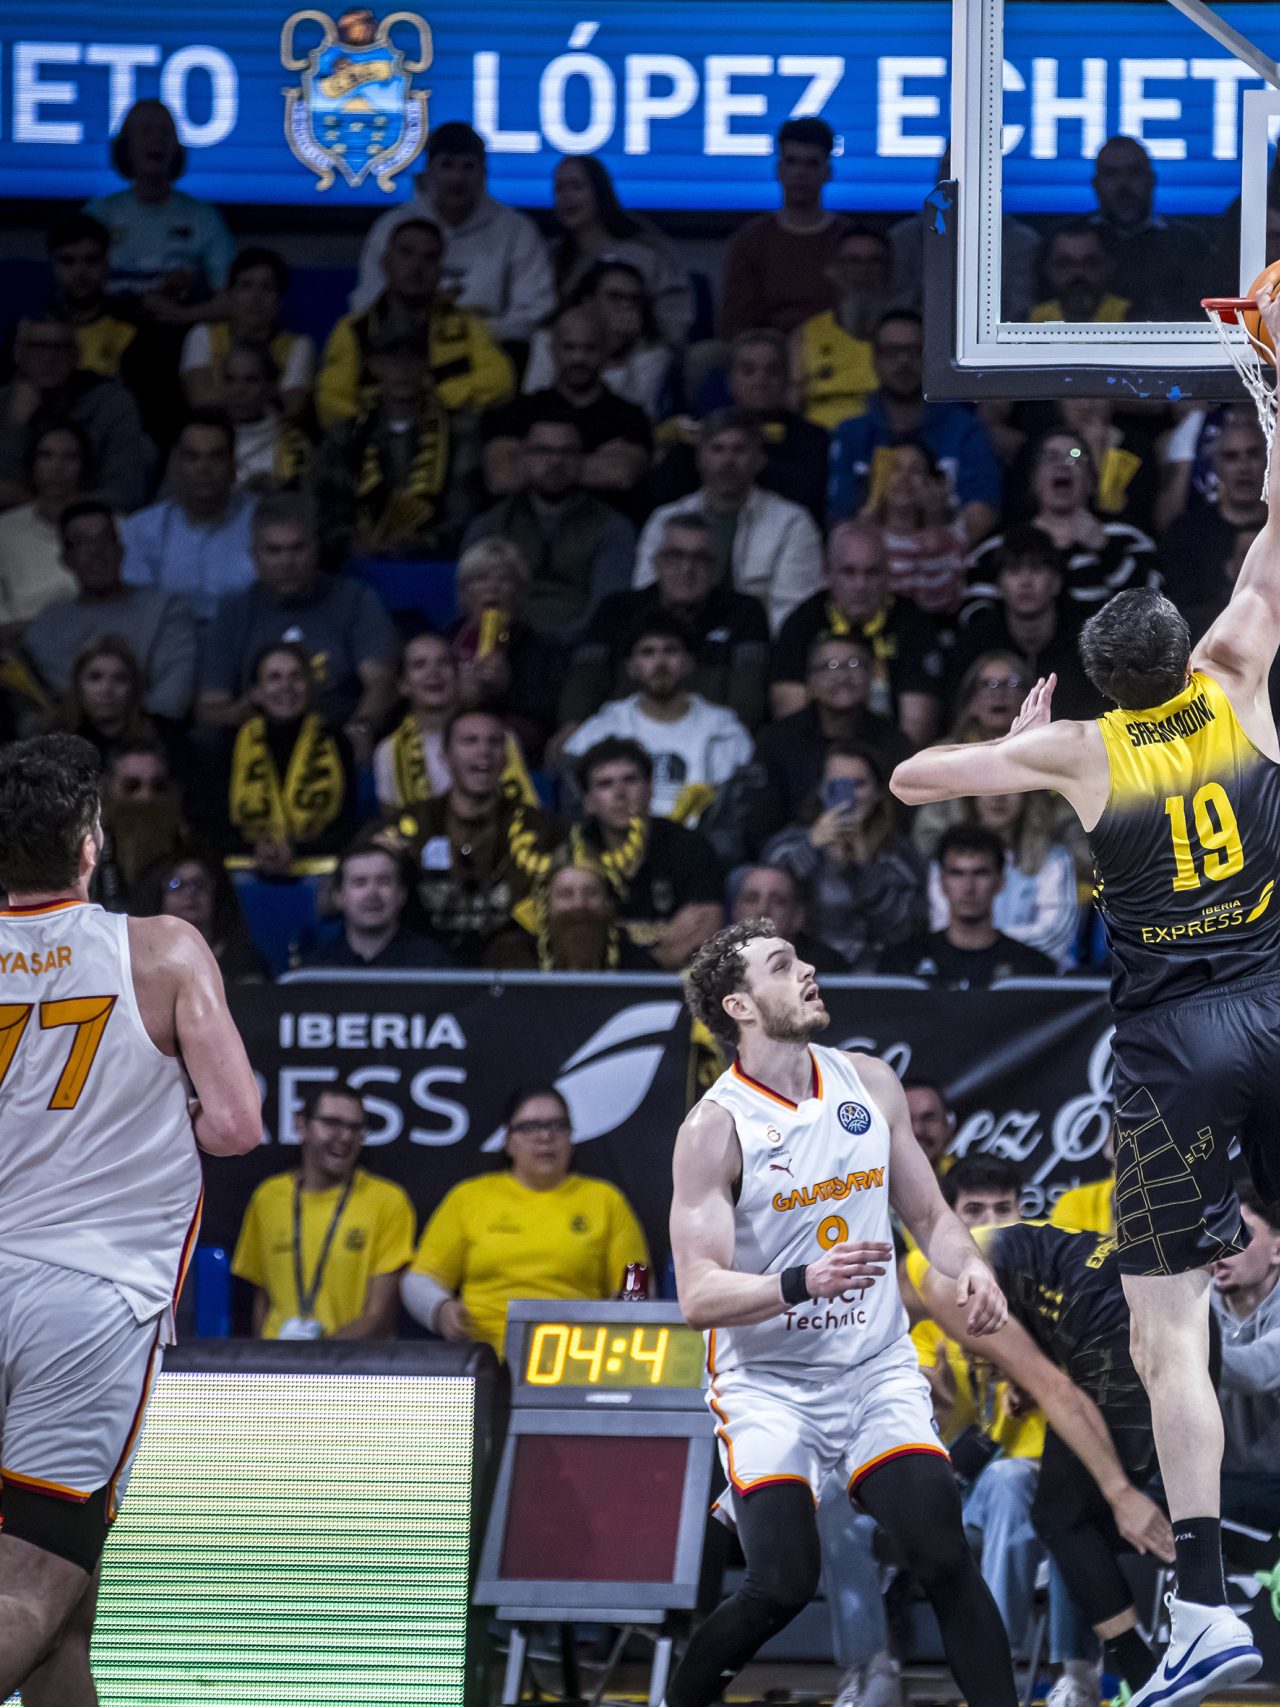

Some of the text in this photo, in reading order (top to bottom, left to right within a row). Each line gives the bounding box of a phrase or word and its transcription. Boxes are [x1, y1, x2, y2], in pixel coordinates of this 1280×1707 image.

[472, 21, 845, 156] LÓPEZ
[1165, 782, 1245, 892] 19
[1201, 899, 1241, 916] IBERIA
[1142, 910, 1244, 944] EXPRESS
[278, 1012, 467, 1049] IBERIA
[256, 1065, 470, 1147] ESS
[784, 1308, 867, 1331] Technic
